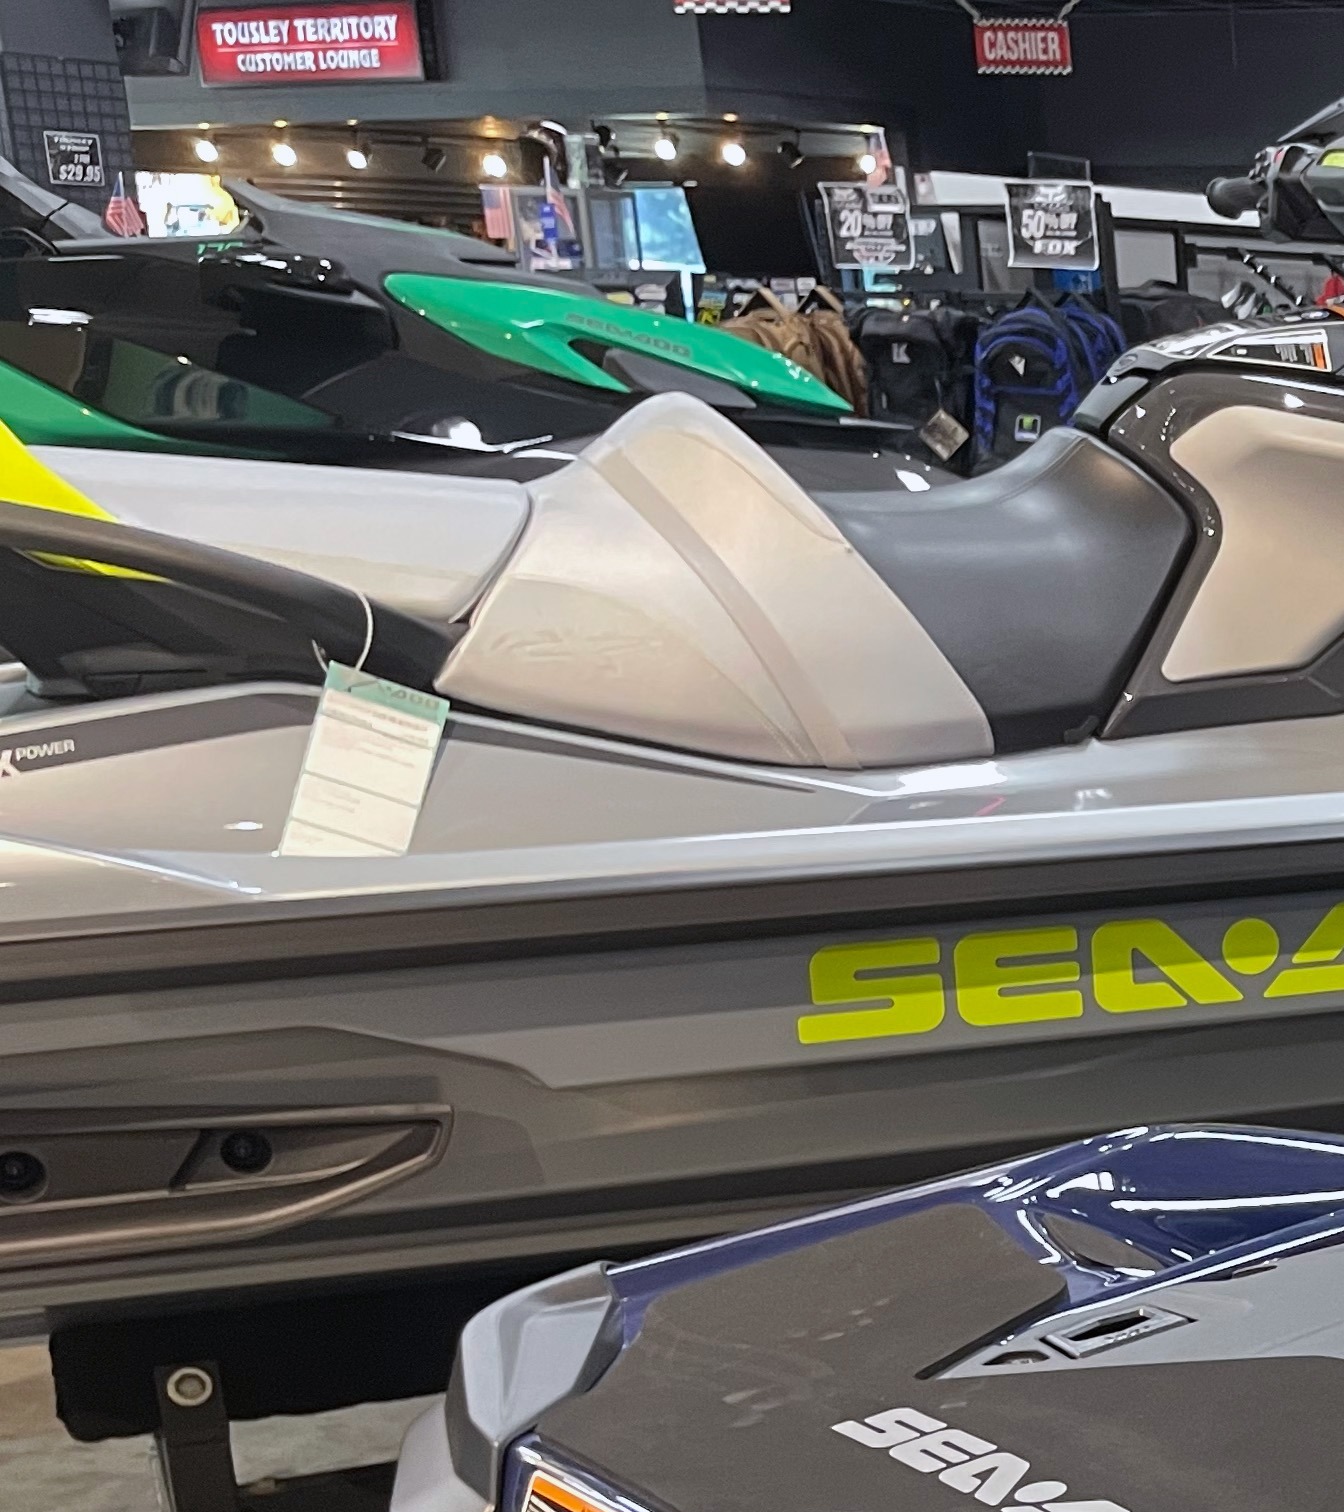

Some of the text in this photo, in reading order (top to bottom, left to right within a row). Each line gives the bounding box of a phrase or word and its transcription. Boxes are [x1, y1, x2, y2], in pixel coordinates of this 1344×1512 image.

[211, 14, 398, 46] TOUSLEY TERRITORY
[983, 31, 1061, 60] CASHIER
[236, 48, 381, 72] CUSTOMER LOUNGE
[15, 738, 76, 762] POWER
